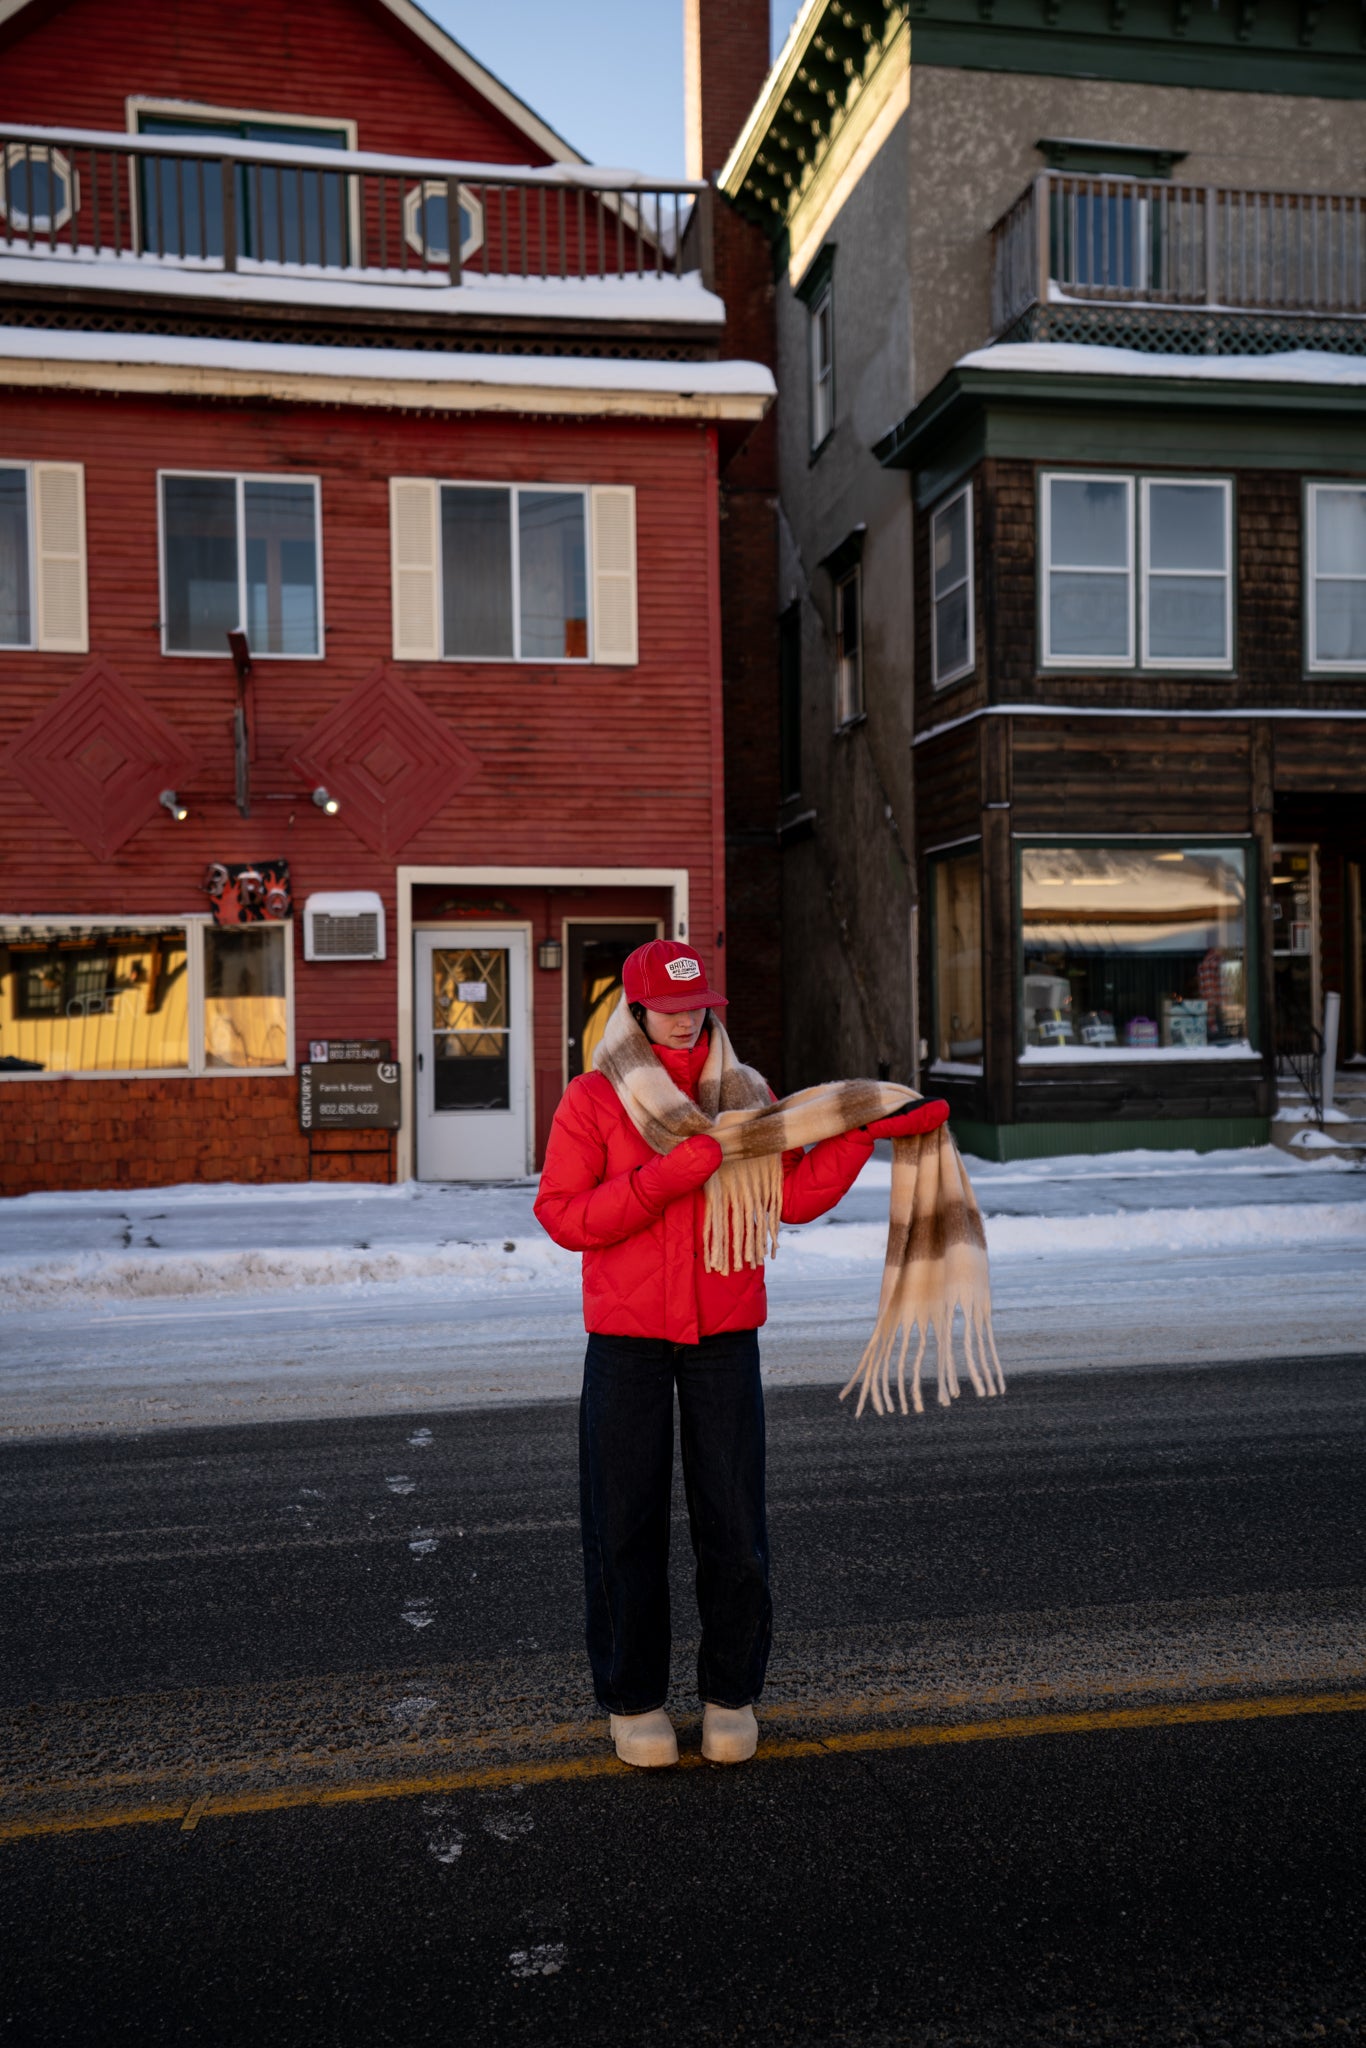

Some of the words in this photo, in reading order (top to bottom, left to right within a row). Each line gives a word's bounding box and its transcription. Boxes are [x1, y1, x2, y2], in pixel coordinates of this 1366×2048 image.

[669, 959, 696, 970] BRIXTON
[66, 993, 140, 1020] OPEN
[319, 1084, 339, 1092] Farm
[340, 1084, 346, 1092] &
[348, 1084, 373, 1092] Forest
[302, 1077, 312, 1128] CENTURY
